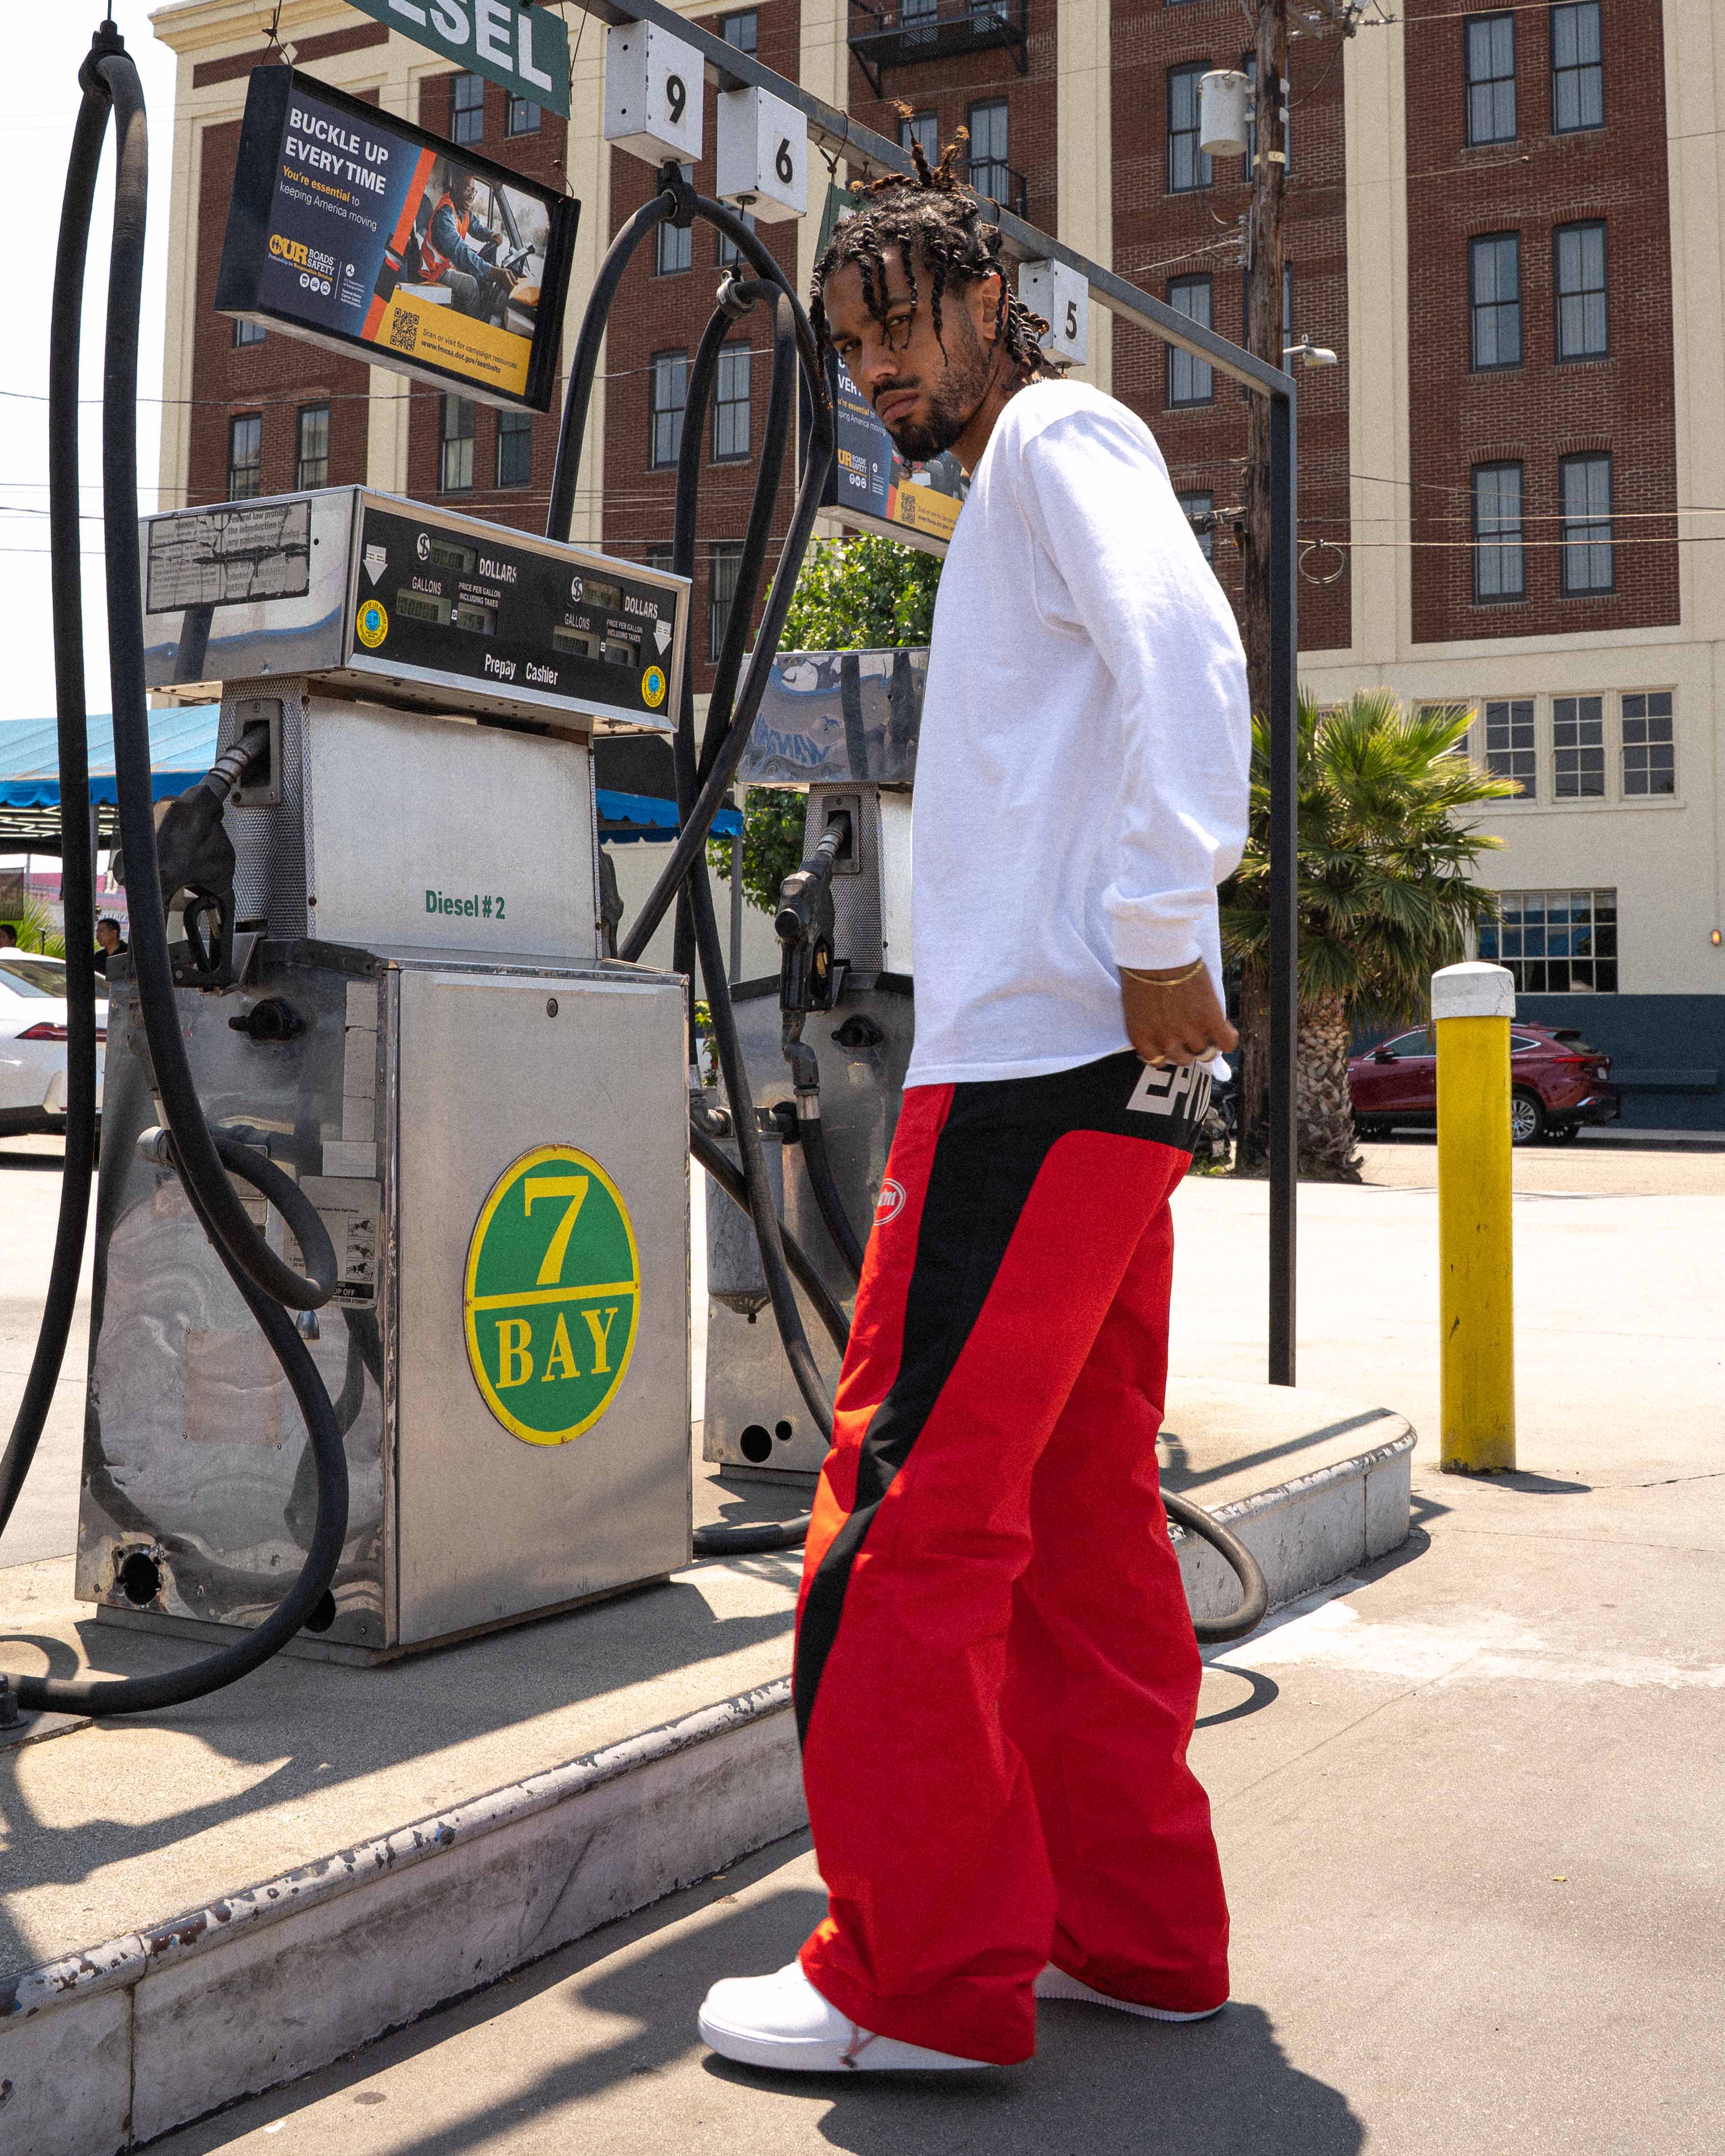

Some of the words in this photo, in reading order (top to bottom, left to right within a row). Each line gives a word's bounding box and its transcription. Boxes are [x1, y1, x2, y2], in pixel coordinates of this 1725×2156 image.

[388, 0, 552, 92] SEL
[666, 75, 686, 124] 9
[290, 108, 360, 155] BUCKLE
[365, 141, 389, 165] UP
[285, 136, 344, 175] EVERY
[346, 161, 386, 195] TIME
[775, 138, 793, 183] 6
[283, 165, 309, 185] You're
[311, 180, 350, 202] essential
[352, 196, 360, 206] to
[280, 181, 312, 205] keeping
[313, 196, 347, 217] America
[349, 211, 377, 232] moving
[269, 234, 309, 265] OUR
[309, 249, 334, 265] ROADS
[307, 258, 335, 275] SAFETY
[1065, 300, 1077, 340] 5
[423, 328, 436, 338] Scan
[445, 337, 456, 347] visit
[457, 341, 465, 350] for
[466, 346, 491, 360] campaign
[492, 355, 518, 369] resources:
[838, 374, 861, 396] VER
[838, 397, 848, 408] u're
[848, 403, 869, 416] essential
[870, 411, 875, 419] to
[850, 413, 869, 428] America
[870, 423, 886, 436] moving
[838, 447, 852, 467] UR
[852, 462, 867, 473] SAFETY
[253, 512, 263, 520] law
[265, 508, 292, 520] prohibs
[228, 539, 239, 547] any
[267, 530, 300, 542] conining
[239, 521, 276, 534] introduction
[479, 558, 517, 583] DOLLARS
[412, 576, 441, 595] GALLONS
[459, 582, 472, 591] PRICE
[473, 585, 482, 594] PER
[483, 588, 501, 598] GALLON
[459, 592, 484, 604] INCLUDING
[485, 597, 499, 608] TAXES
[625, 595, 658, 619] DOLLARS
[565, 613, 590, 630] GALLONS
[607, 619, 618, 628] PRICE
[627, 624, 643, 633] GALLON
[607, 629, 628, 639] INCLUDING
[628, 633, 641, 642] TAXES
[485, 653, 516, 680] Prepay
[526, 662, 559, 685] Cashier
[426, 890, 479, 917] Diesel
[524, 1175, 589, 1285] 7
[495, 1307, 619, 1389] BAY
